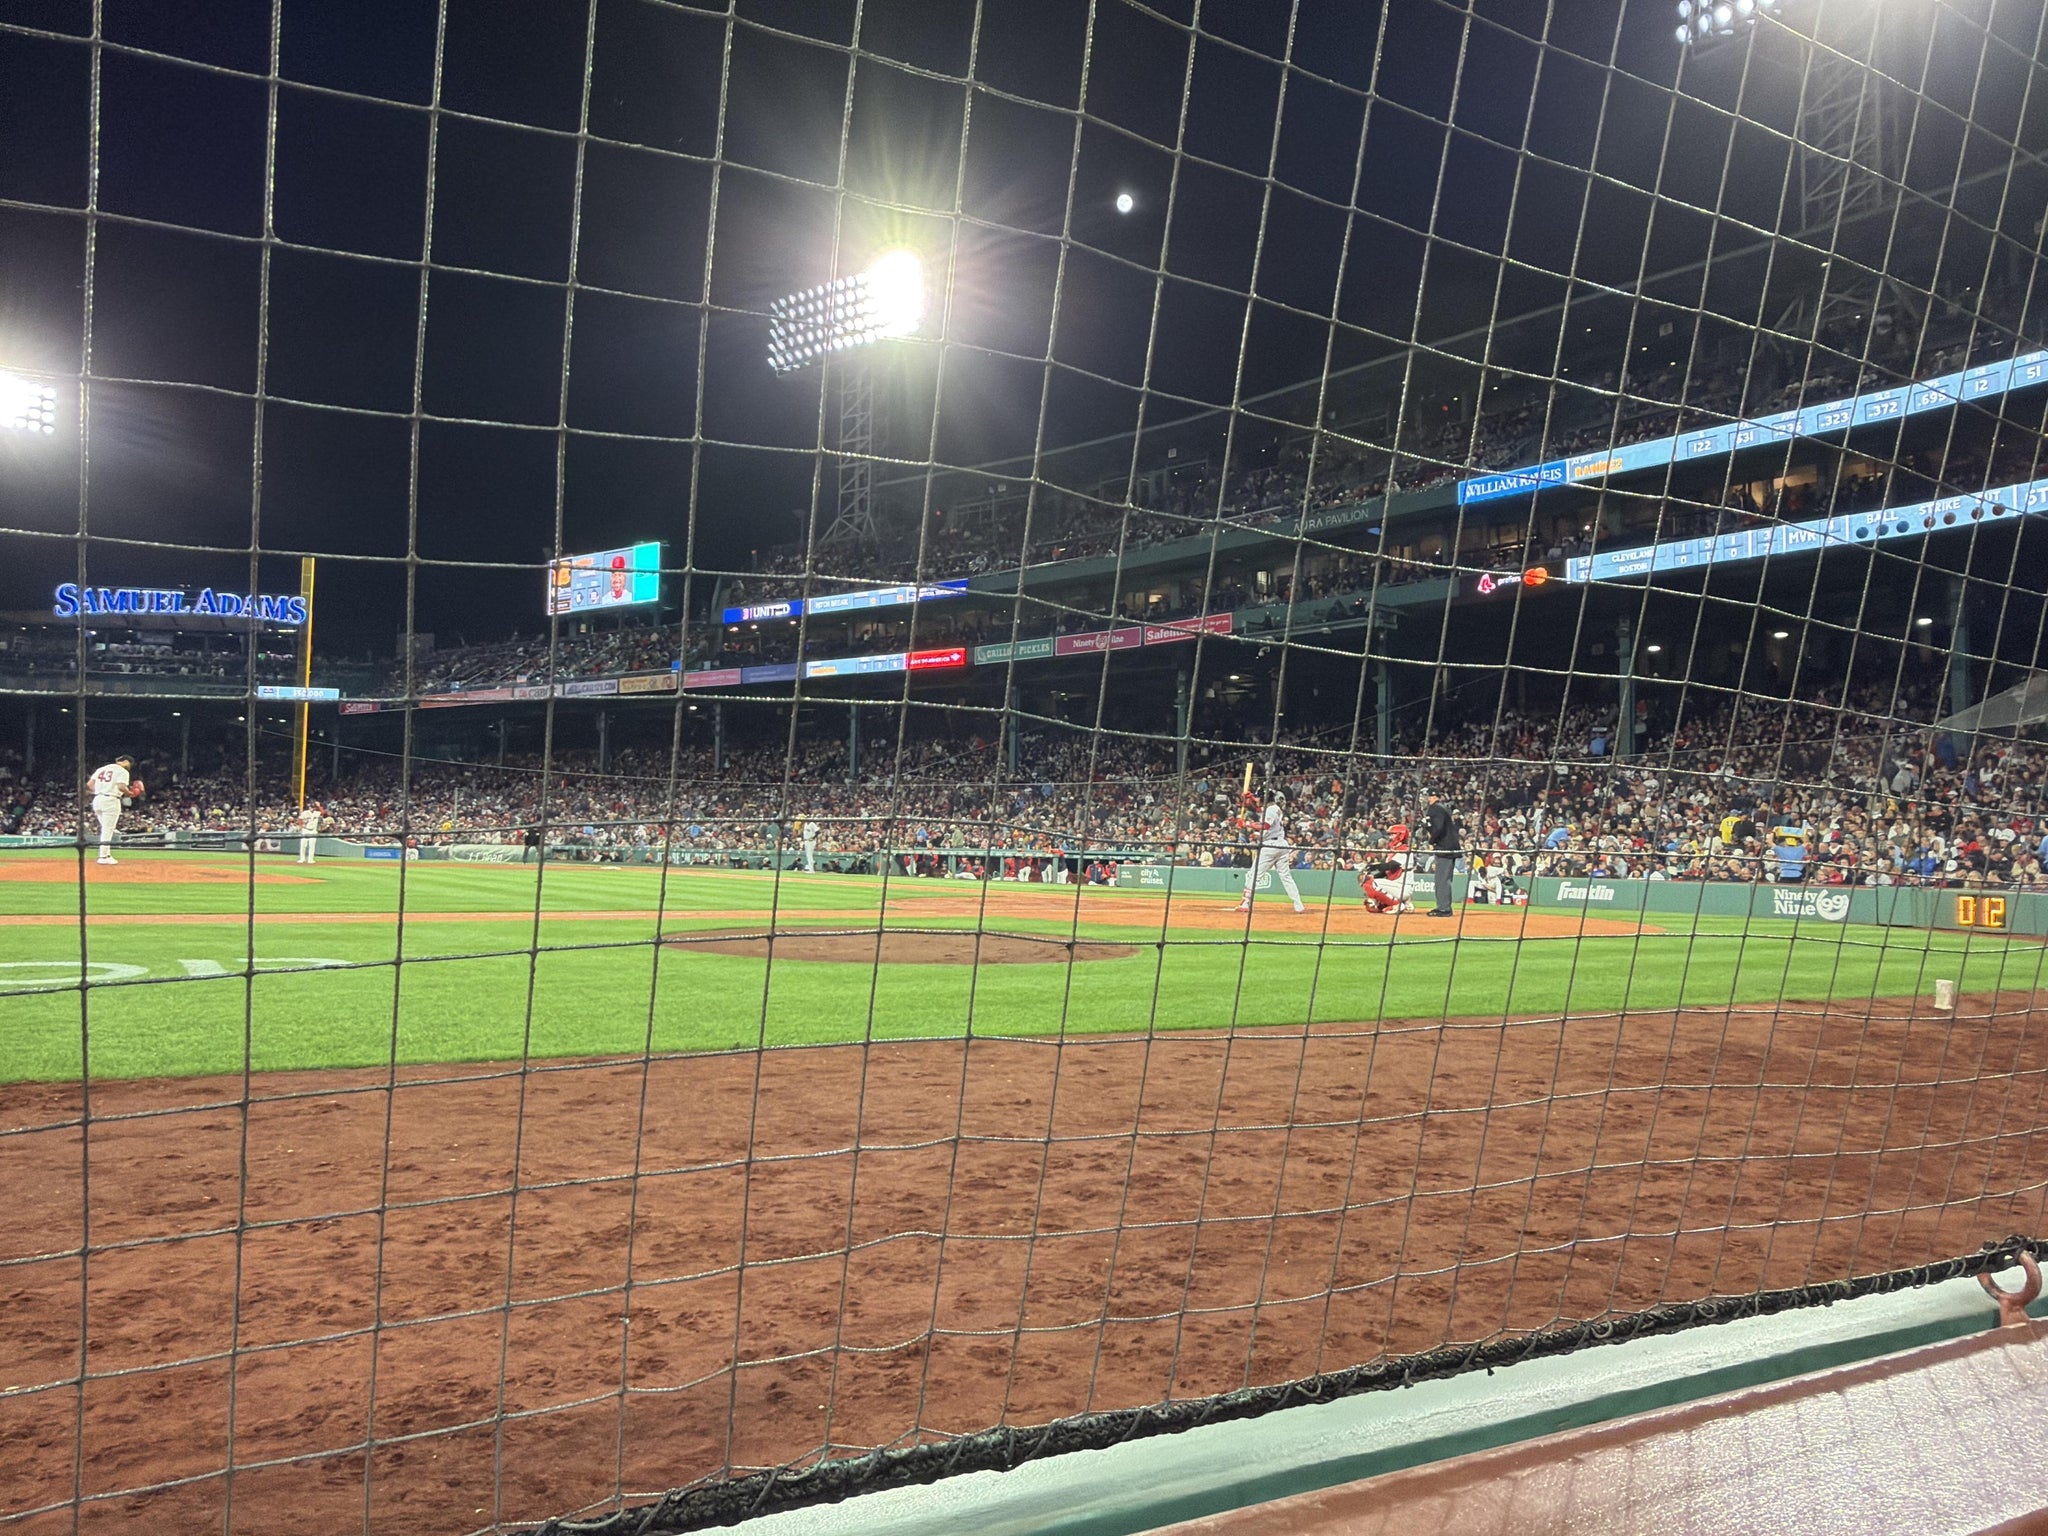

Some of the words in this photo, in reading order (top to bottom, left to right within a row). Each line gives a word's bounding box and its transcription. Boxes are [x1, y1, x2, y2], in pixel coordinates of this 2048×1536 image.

[2026, 365, 2041, 379] 51
[1974, 379, 1988, 392] 12
[1868, 402, 1898, 417] .372
[1820, 411, 1849, 427] .323
[1693, 440, 1712, 453] 122
[1466, 474, 1518, 498] WILLIAM
[1325, 508, 1369, 526] PAVILION
[1866, 510, 1899, 525] BALL
[1918, 498, 1962, 516] STRIKE
[1705, 540, 1712, 549] 3
[1788, 530, 1817, 545] MVR
[1618, 562, 1648, 574] BOSTON
[1680, 555, 1687, 564] 0
[1730, 547, 1738, 557] 0
[54, 583, 191, 617] SAMUEL
[192, 587, 308, 625] ADAMS
[753, 603, 791, 618] UNITED
[1019, 643, 1050, 655] PICKLES
[1072, 638, 1096, 649] Ninety
[98, 770, 113, 783] 43
[1557, 881, 1615, 901] Franklin
[1773, 888, 1819, 904] Ninety
[1773, 900, 1816, 916] Nine
